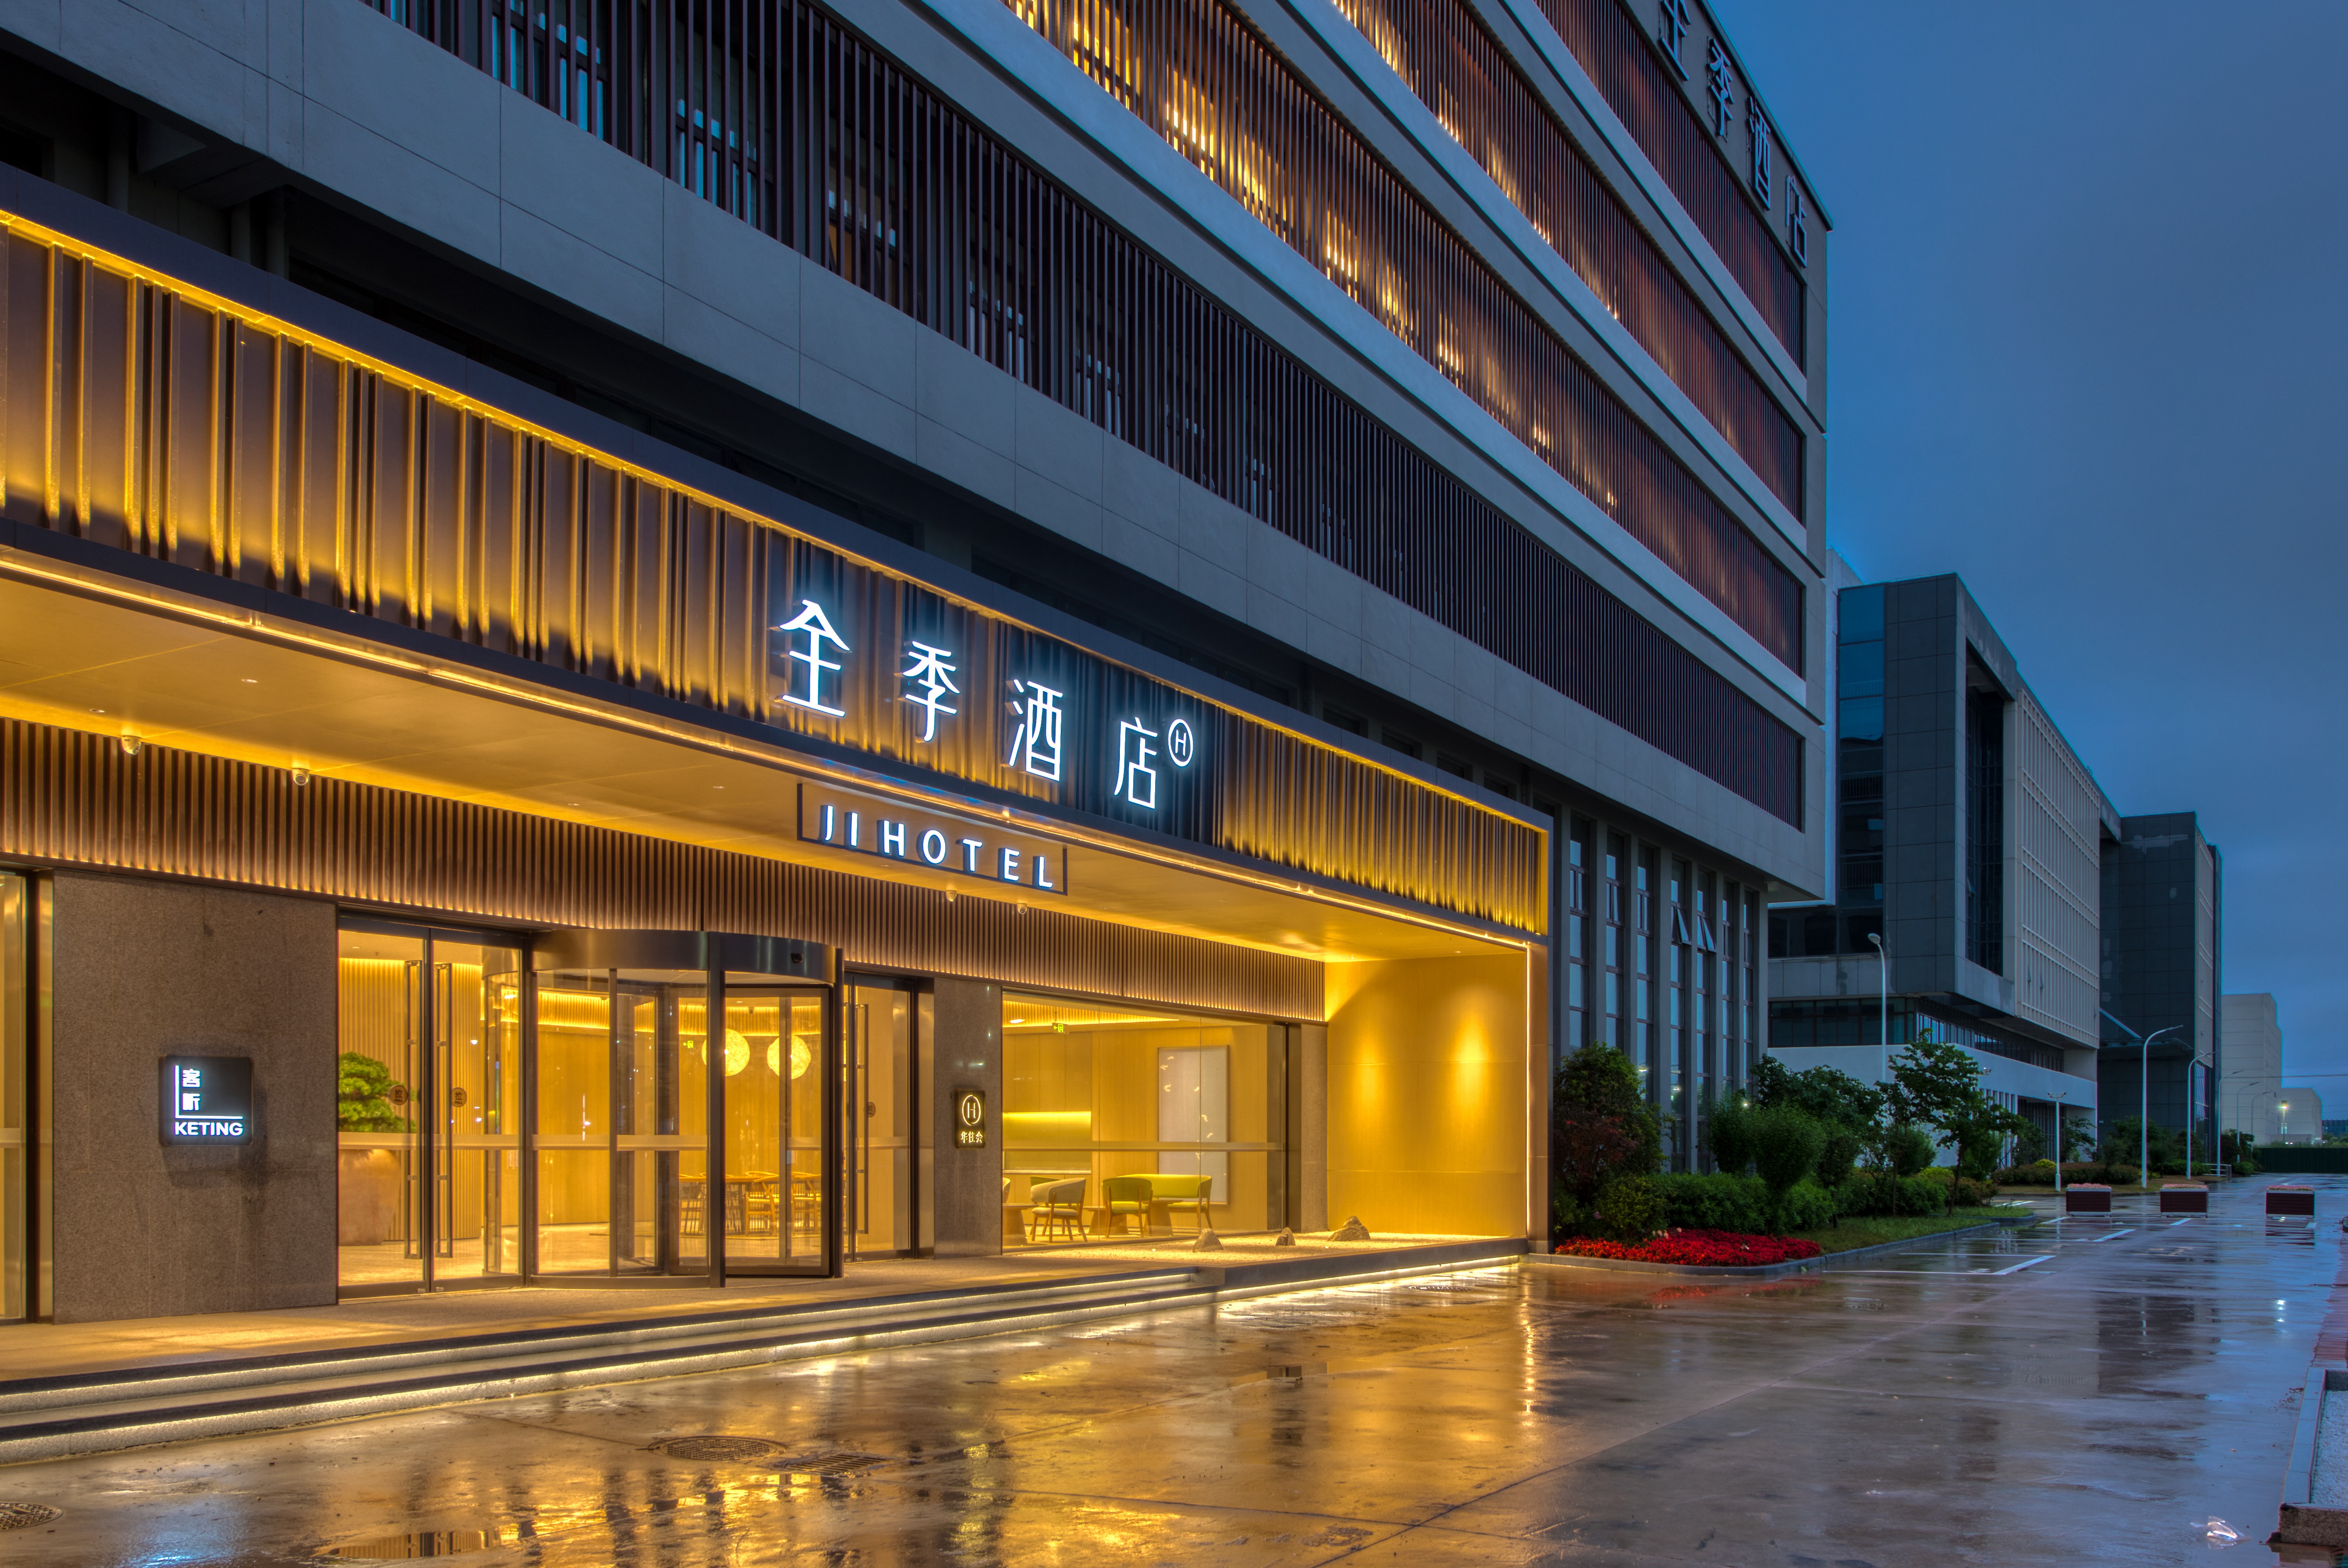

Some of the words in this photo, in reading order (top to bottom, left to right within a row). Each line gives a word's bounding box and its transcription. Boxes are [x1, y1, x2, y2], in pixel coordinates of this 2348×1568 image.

[779, 599, 1158, 809] 全季酒店
[825, 805, 858, 846] JI
[884, 820, 1053, 888] HOTEL
[175, 1122, 243, 1136] KETING
[961, 1131, 983, 1143] 华住会
